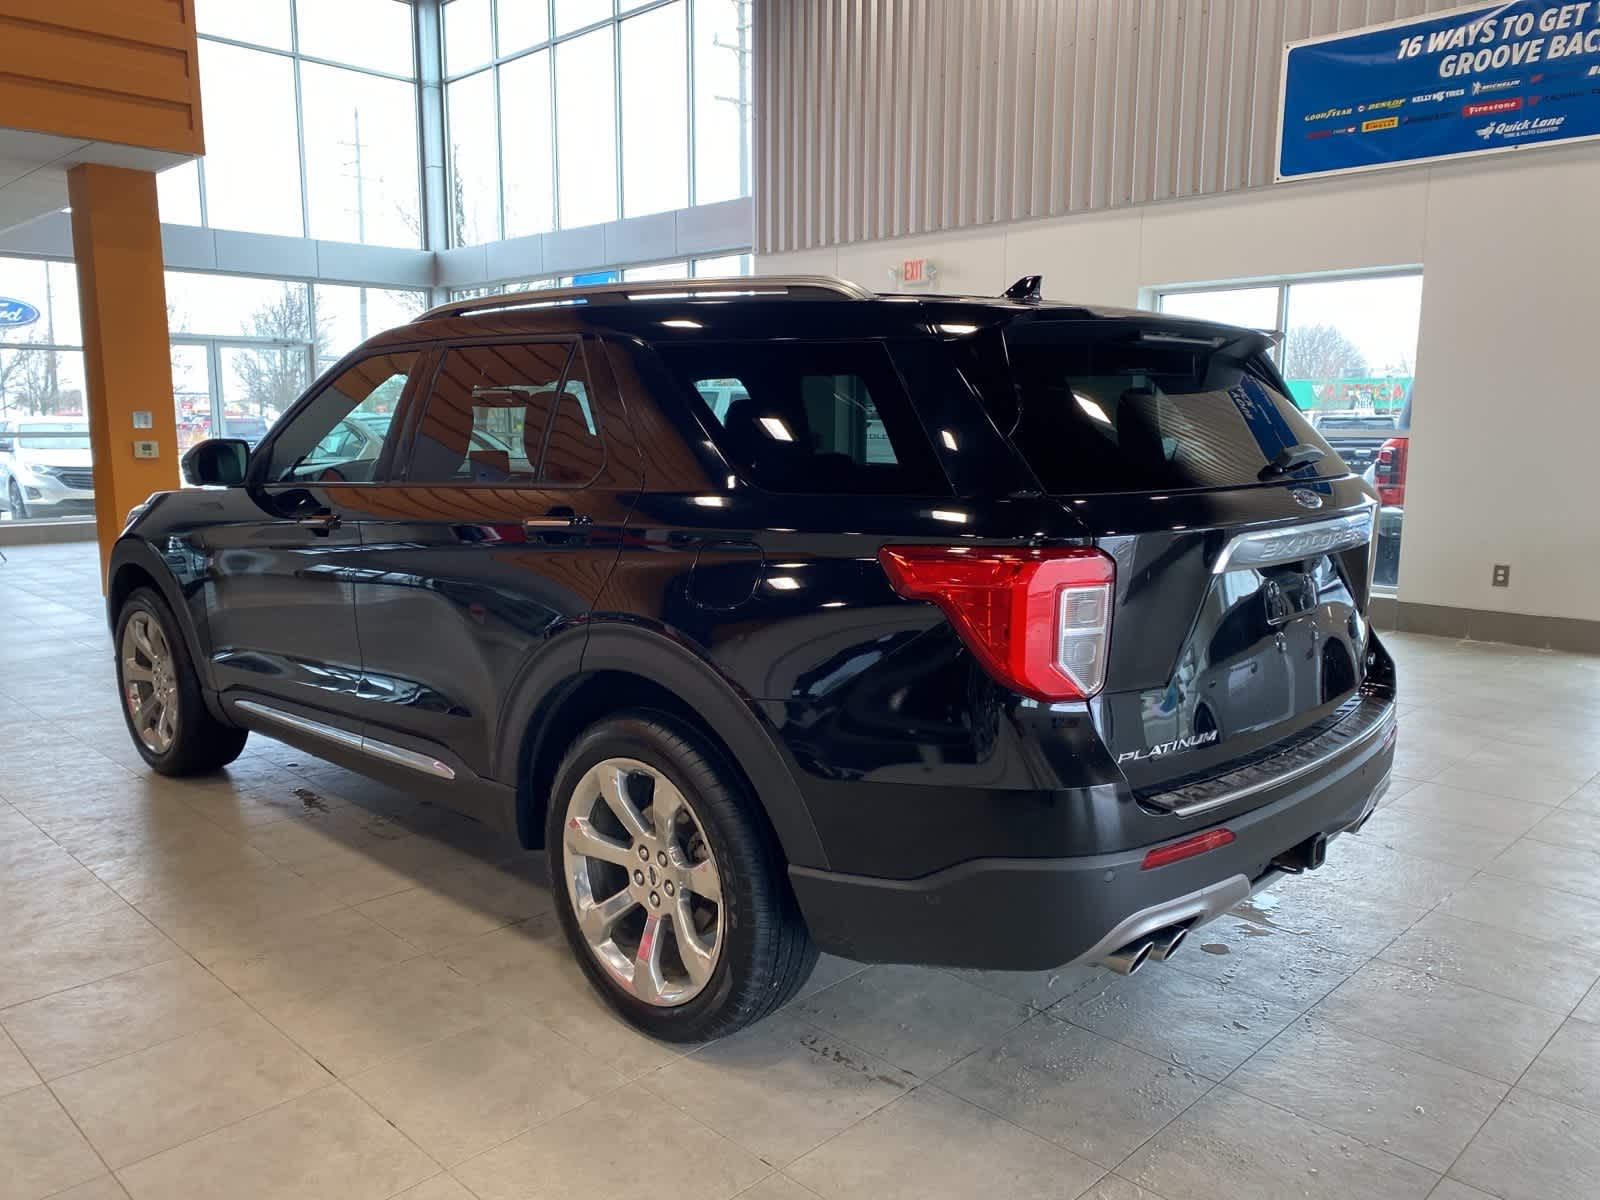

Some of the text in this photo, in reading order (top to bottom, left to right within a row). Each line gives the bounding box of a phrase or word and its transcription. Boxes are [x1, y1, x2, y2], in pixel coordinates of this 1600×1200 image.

[1397, 35, 1424, 60] 16
[1427, 19, 1498, 53] WAYS
[1502, 12, 1535, 40] TO
[1539, 2, 1591, 32] GET
[1438, 28, 1600, 78] GROOVE BAC
[1480, 79, 1520, 90] MICHELIN
[1368, 98, 1407, 111] DUNLOP
[1469, 101, 1517, 115] Firestone
[1304, 108, 1353, 122] GOODYEAR
[1494, 116, 1565, 135] Quick Lane
[904, 260, 924, 281] EXIT
[1117, 729, 1218, 764] PLATINUM
